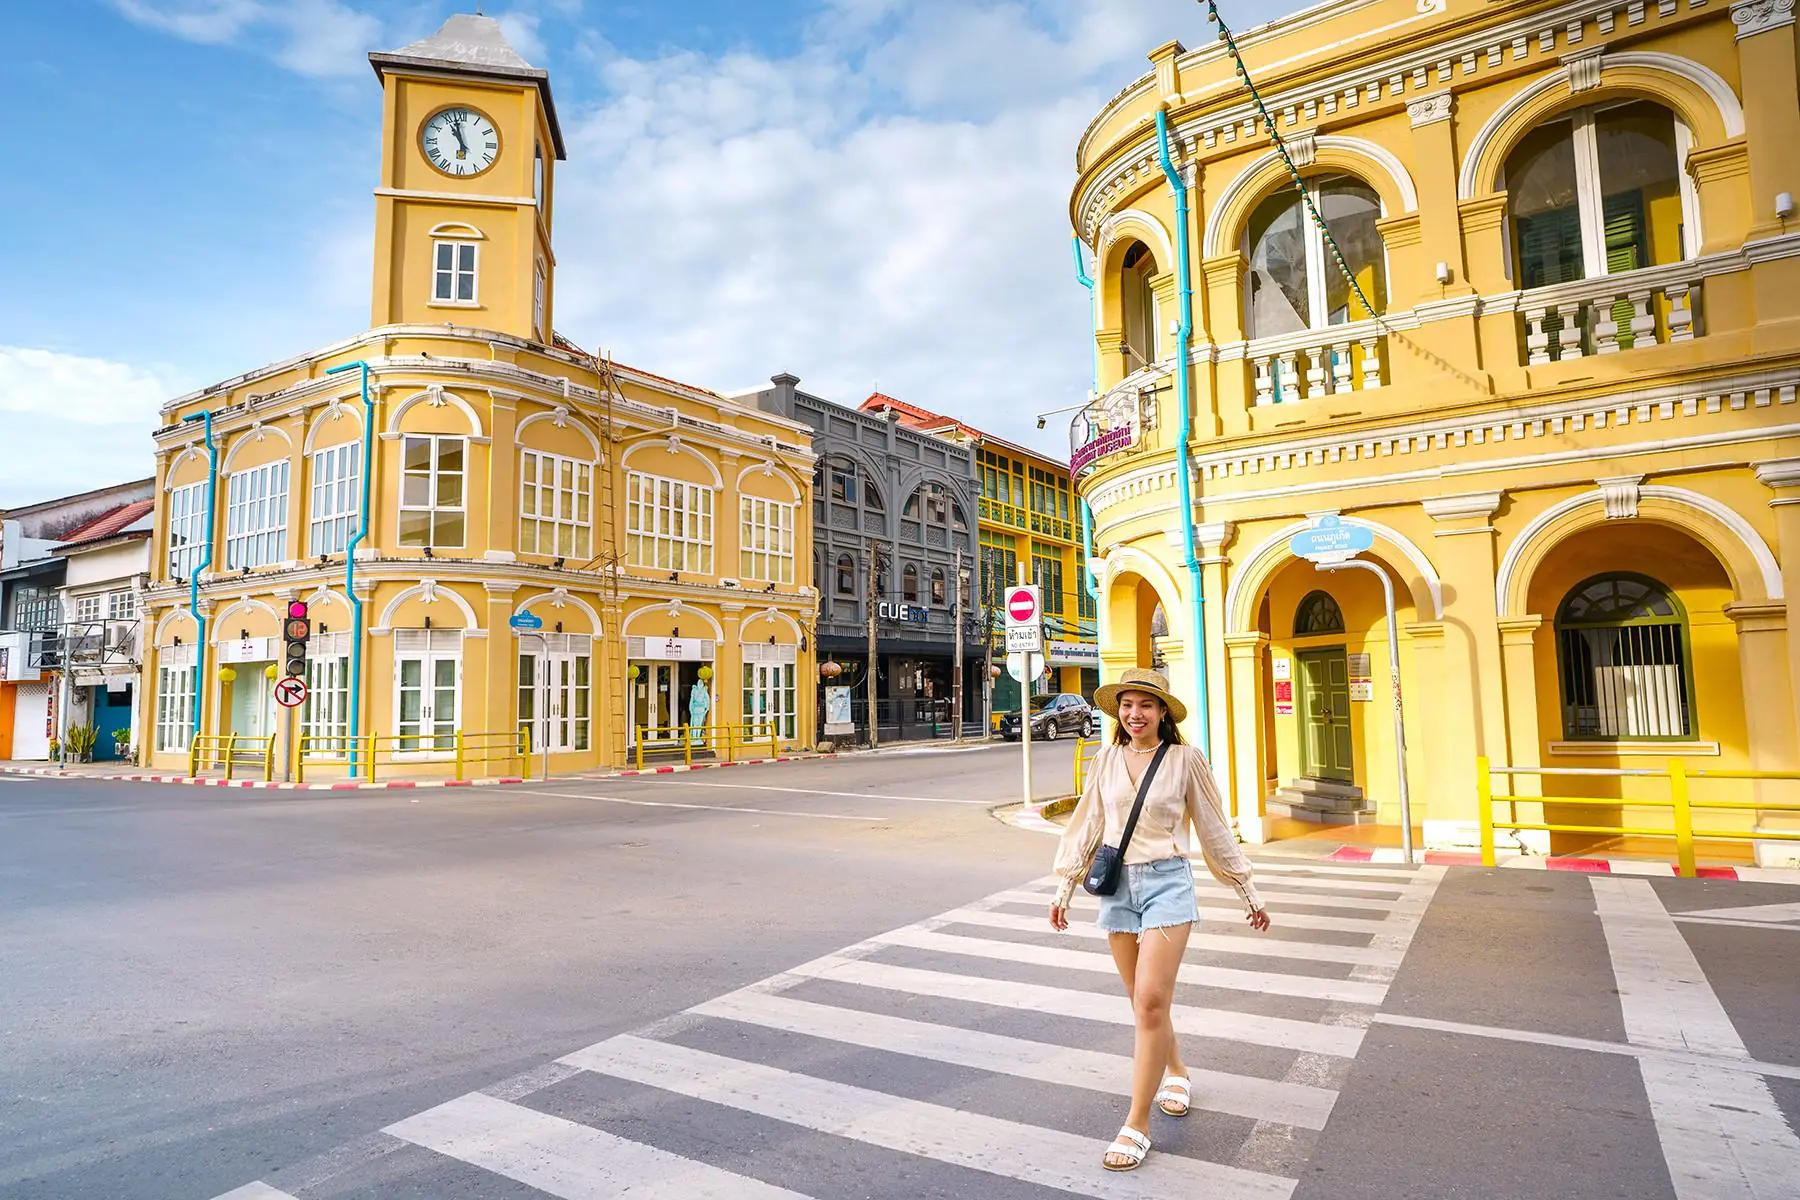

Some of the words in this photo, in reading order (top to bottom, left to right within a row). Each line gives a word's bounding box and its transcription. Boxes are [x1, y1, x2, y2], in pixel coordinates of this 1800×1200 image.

[430, 122, 442, 133] X
[482, 128, 494, 136] II
[426, 136, 438, 145] IX
[482, 152, 494, 164] IV
[439, 158, 451, 172] VII
[456, 164, 465, 175] VI
[473, 163, 481, 173] V
[1098, 436, 1132, 457] MUSEUM
[1009, 628, 1037, 640] ห้ามเข้า
